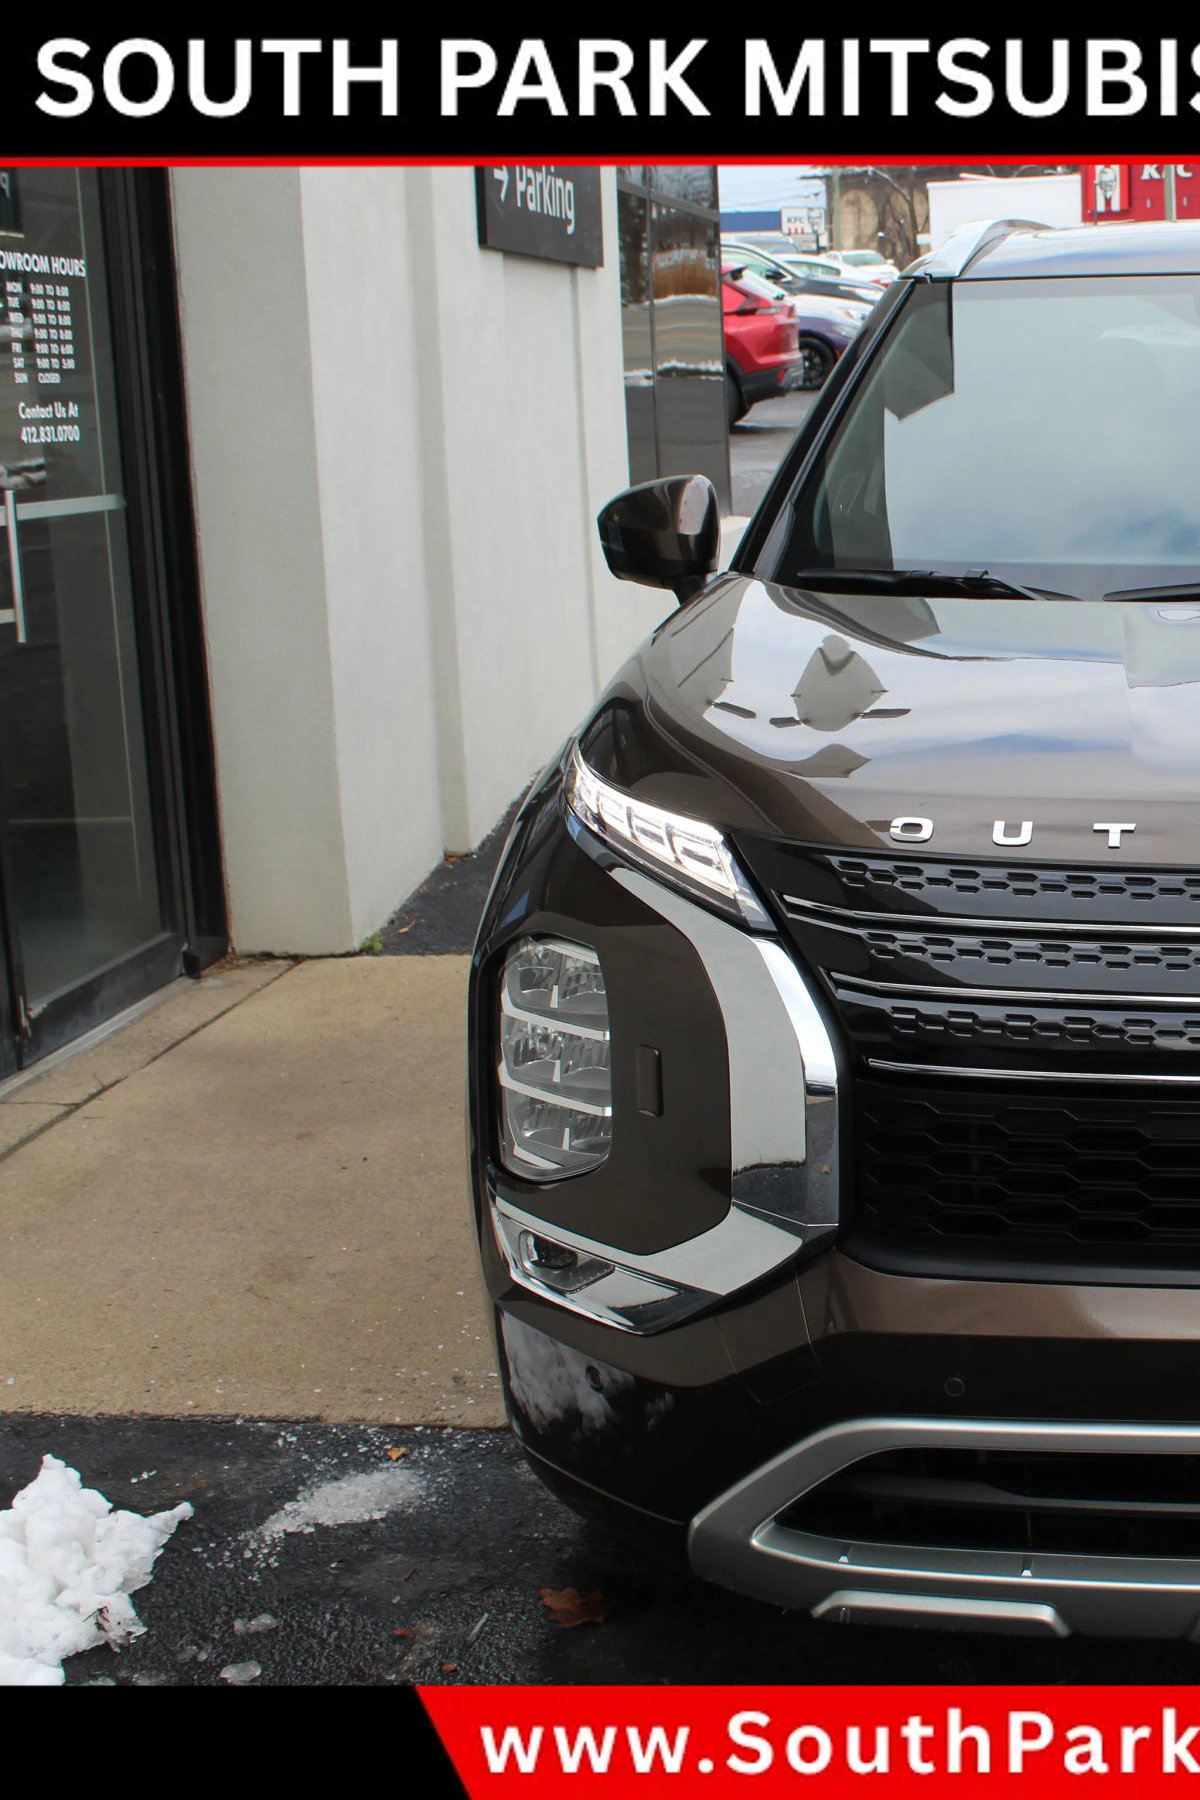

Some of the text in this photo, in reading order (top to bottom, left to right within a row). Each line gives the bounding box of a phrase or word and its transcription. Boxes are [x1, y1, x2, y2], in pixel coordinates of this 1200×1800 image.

[515, 166, 575, 235] Parking
[51, 256, 87, 278] HOURS
[45, 285, 55, 296] TO
[46, 299, 55, 311] TO
[48, 314, 57, 325] TO
[49, 329, 58, 340] TO
[50, 344, 59, 355] TO
[13, 357, 25, 369] SAT
[51, 358, 60, 369] TO
[18, 401, 79, 419] Contact Us At
[20, 425, 80, 444] 412.831.0700
